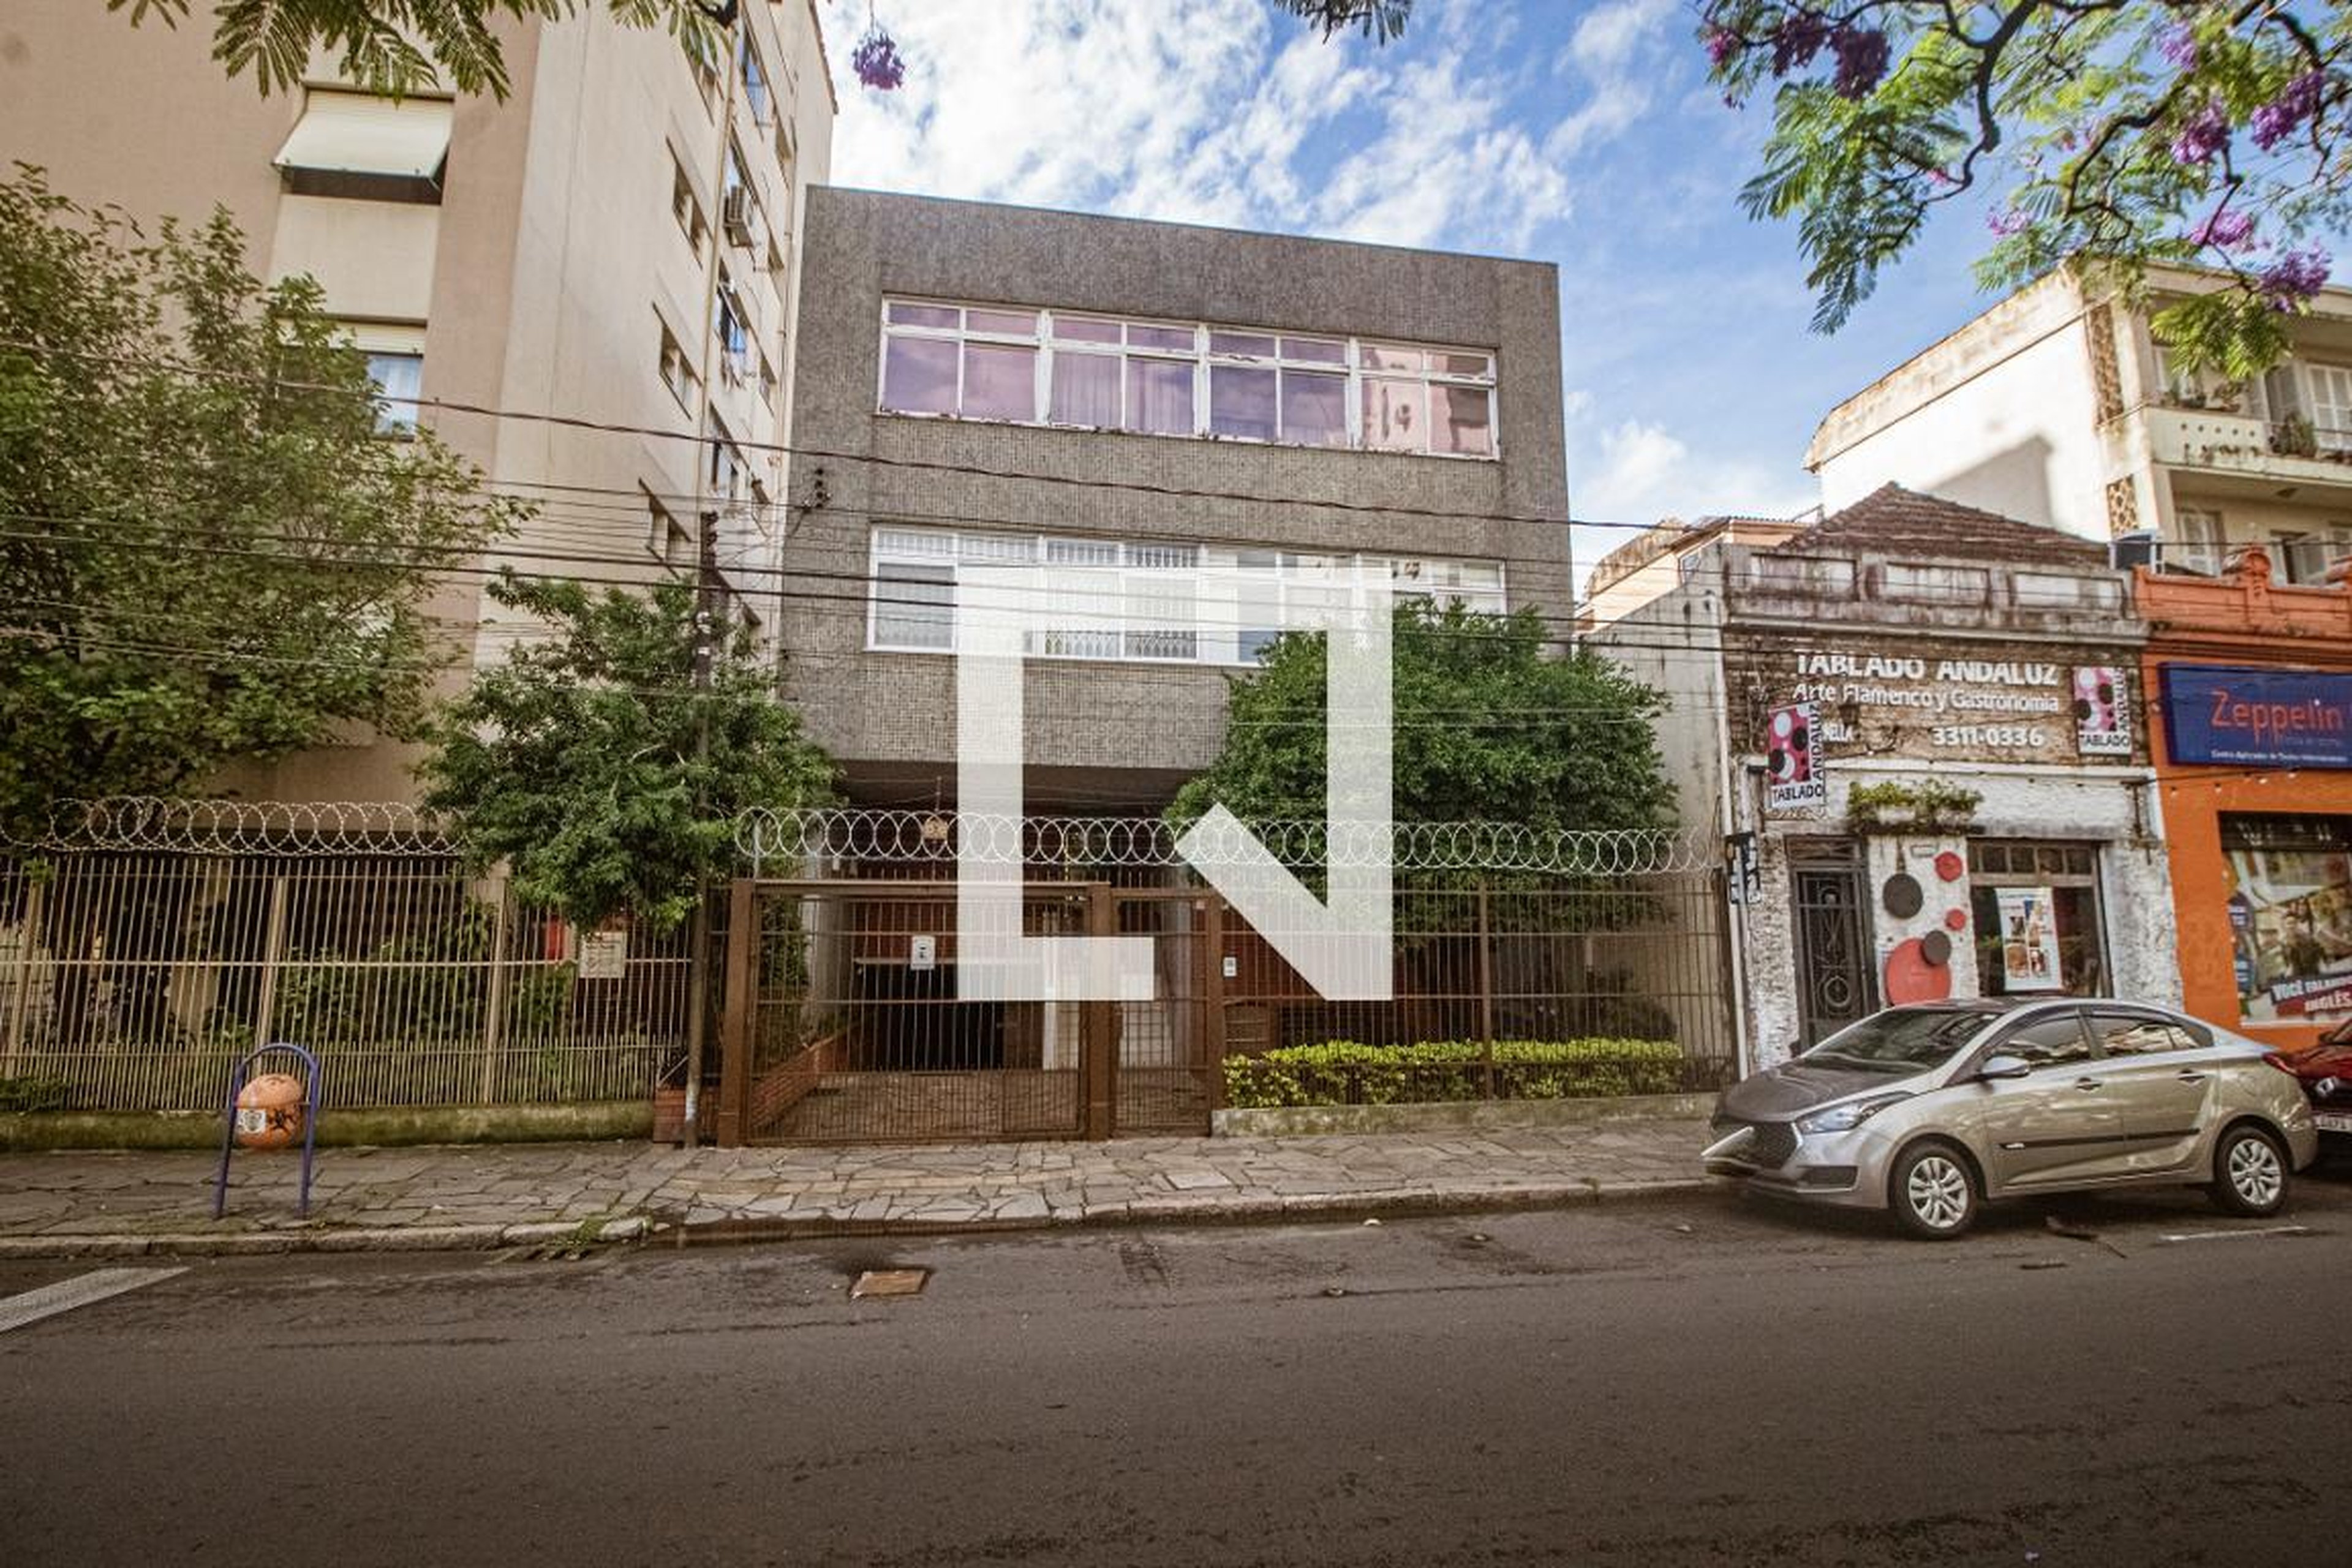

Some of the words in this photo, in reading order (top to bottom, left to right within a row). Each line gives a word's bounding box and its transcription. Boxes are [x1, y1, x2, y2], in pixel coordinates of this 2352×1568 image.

[1795, 649, 1925, 679] TABLADO
[1936, 660, 2059, 685] ANDALUZ
[1792, 683, 1836, 701] Arte
[1842, 684, 1932, 707] Flamenco
[1932, 692, 1947, 713] y
[2209, 690, 2343, 748] Zeppelin
[1809, 704, 1823, 780] ANDALUZ
[1772, 783, 1823, 802] TABLADO
